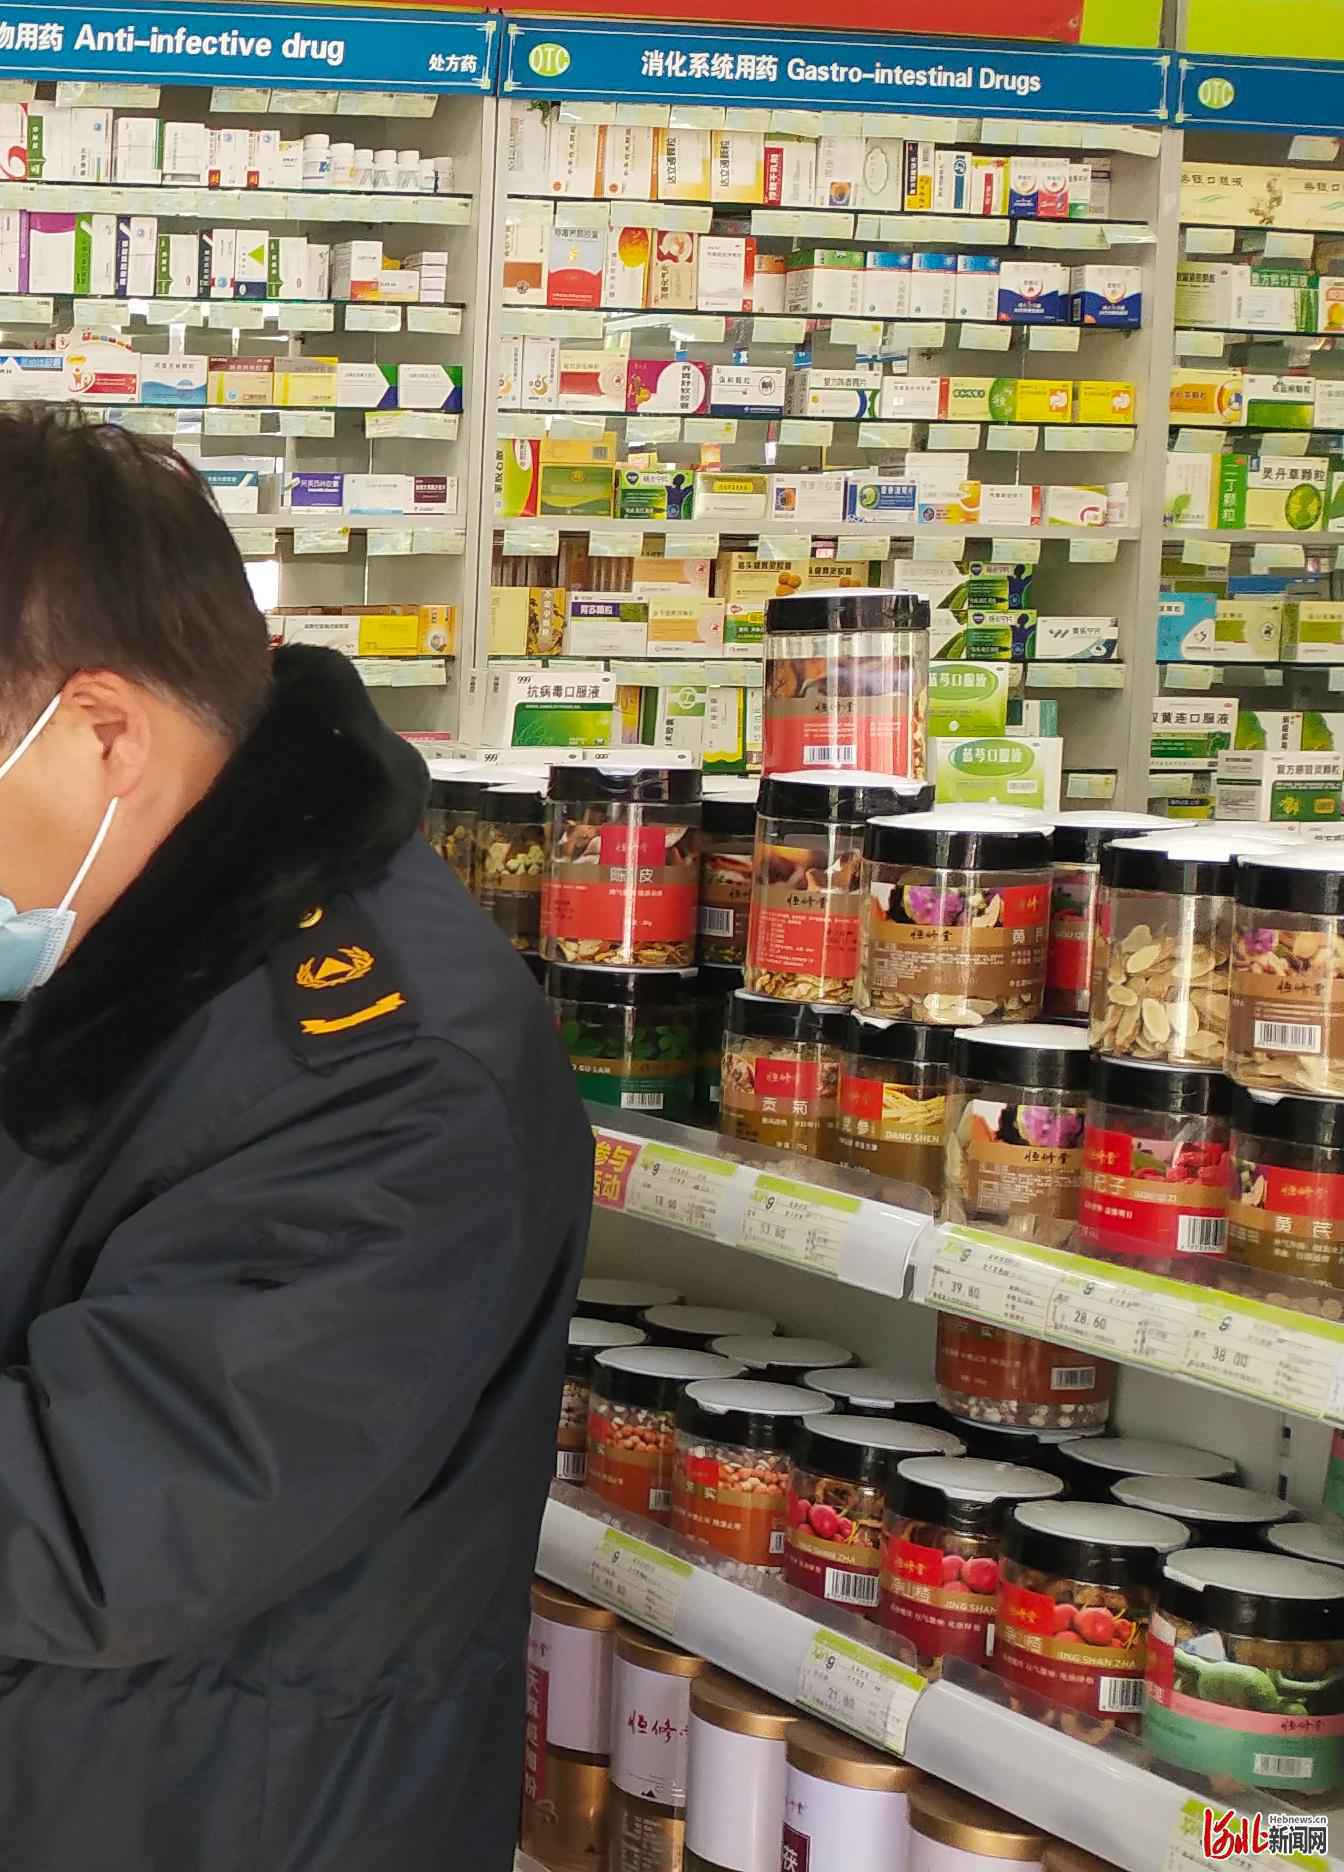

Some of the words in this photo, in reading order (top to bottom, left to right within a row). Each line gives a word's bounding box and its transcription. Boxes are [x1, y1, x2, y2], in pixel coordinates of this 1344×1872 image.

[74, 24, 273, 57] Anti-infective
[281, 32, 345, 67] drug
[429, 53, 479, 74] 处方药
[529, 45, 570, 74] OTC
[641, 50, 778, 82] 消化系统用药
[787, 58, 972, 89] Gastro-intestinal
[979, 67, 1041, 96] Drugs
[1260, 466, 1327, 481] 灵丹草颗粒
[527, 682, 601, 700] 抗病毒口服液
[960, 746, 1025, 765] 蓝芩口服液
[1275, 762, 1343, 776] 复方感冒灵颗粒
[914, 1132, 941, 1145] SHEN
